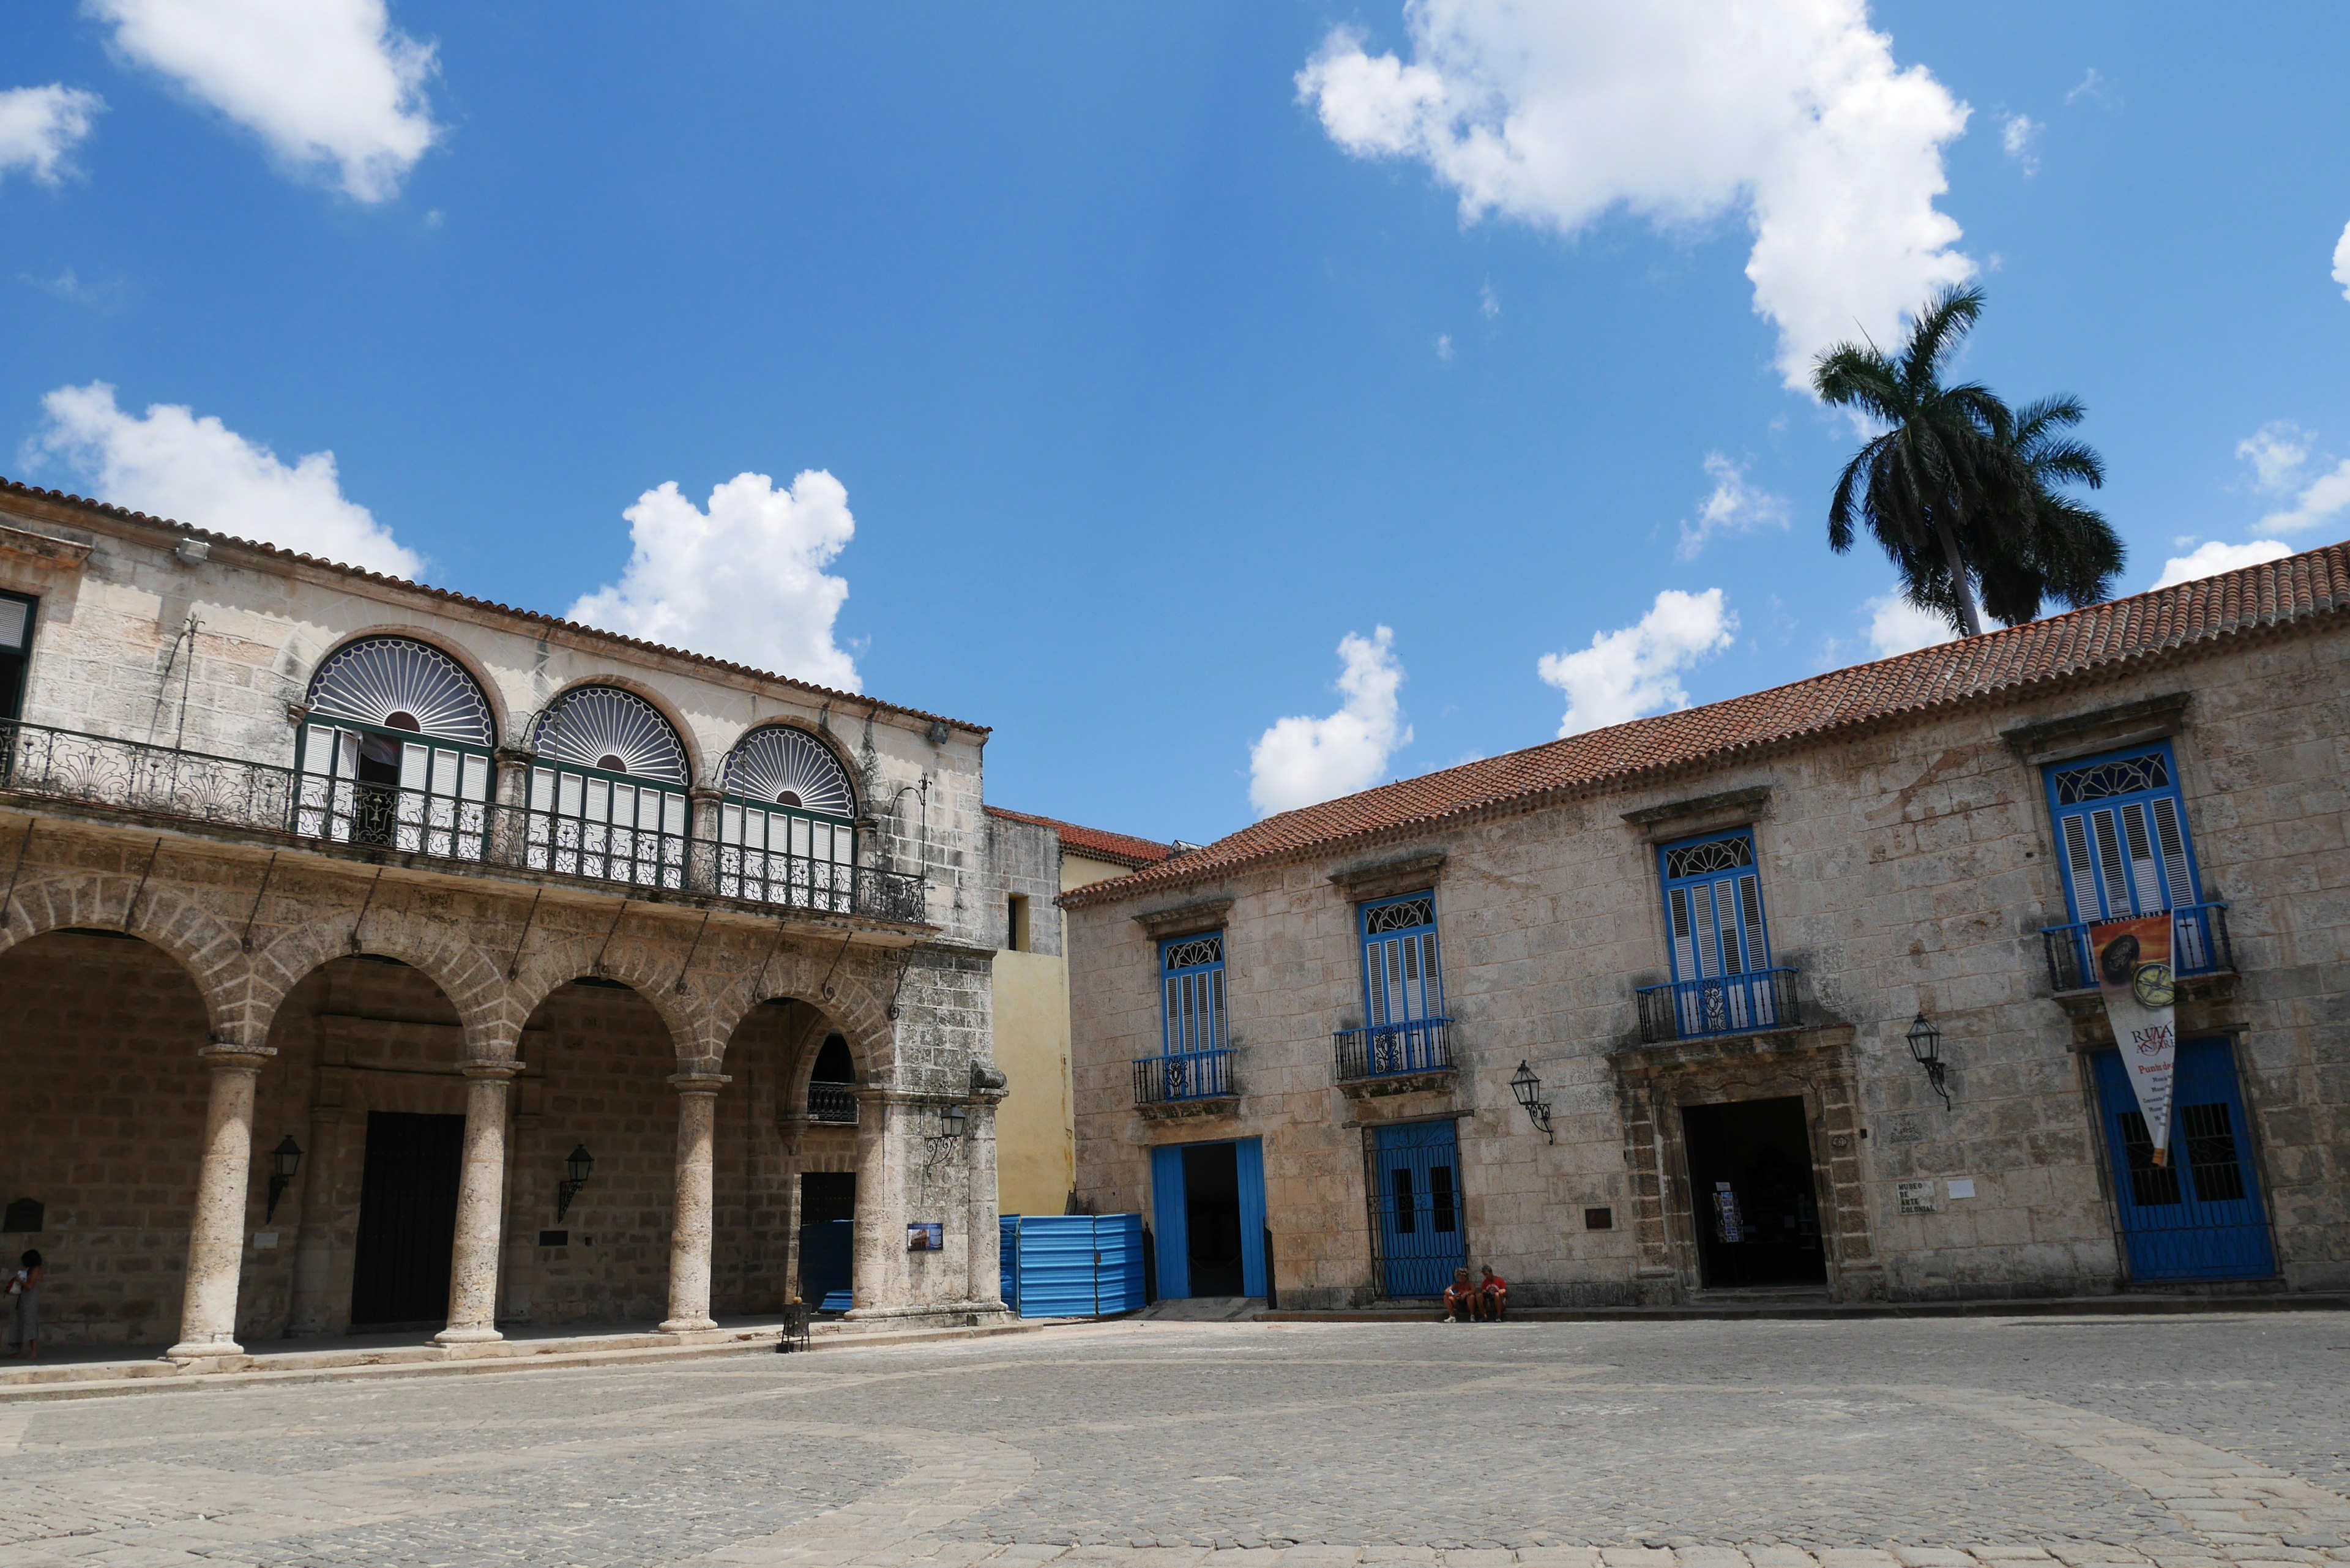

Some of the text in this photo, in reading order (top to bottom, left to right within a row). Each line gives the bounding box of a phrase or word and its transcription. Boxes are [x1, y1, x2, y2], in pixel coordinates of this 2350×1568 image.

[2100, 911, 2163, 925] VERANO 2016
[1901, 1205, 1936, 1214] COLONIAL
